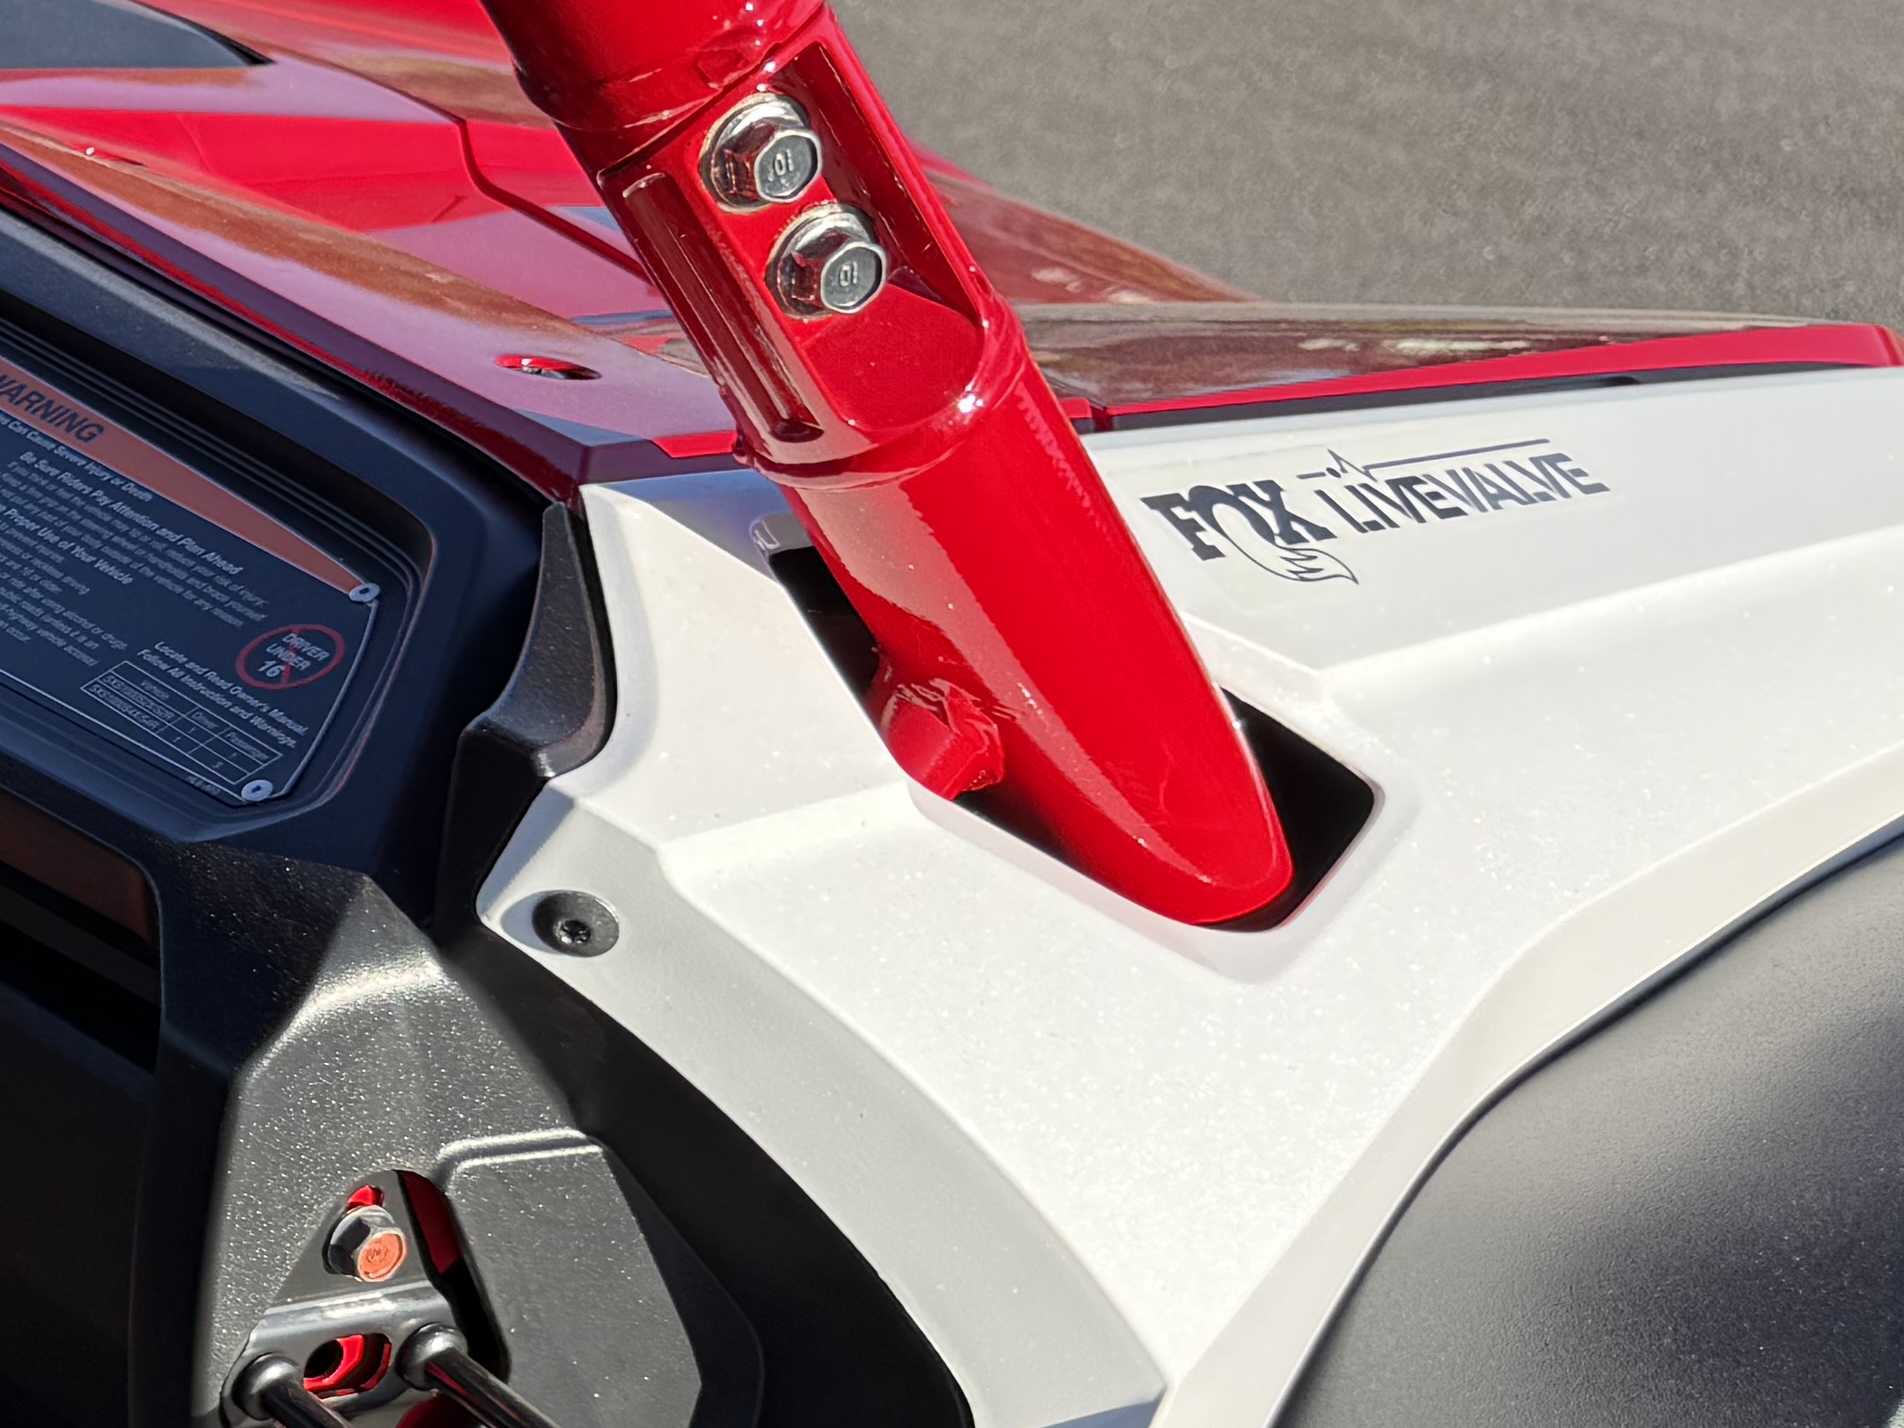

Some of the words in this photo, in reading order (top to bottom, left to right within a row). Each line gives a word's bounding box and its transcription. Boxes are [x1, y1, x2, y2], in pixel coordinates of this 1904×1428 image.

[7, 420, 29, 435] Can
[19, 451, 37, 464] Be
[34, 459, 60, 476] Sure
[57, 471, 93, 494] Riders
[89, 489, 113, 506] Pay
[108, 501, 159, 531] Attention
[155, 527, 184, 542] and
[176, 537, 205, 555] Plan
[201, 551, 243, 575] Ahead
[1142, 478, 1338, 562] FOX
[3, 508, 41, 531] Proper
[37, 526, 60, 543] Use
[57, 540, 75, 549] of
[70, 545, 97, 563] Your
[93, 558, 133, 584] Vehicle
[154, 641, 188, 663] Locate
[184, 661, 209, 675] and
[203, 671, 234, 690] Read
[258, 660, 286, 677] 16
[266, 643, 311, 670] UNDER
[282, 633, 330, 660] DRIVER
[137, 648, 170, 670] Follow
[167, 667, 185, 678] All
[229, 705, 254, 719] and
